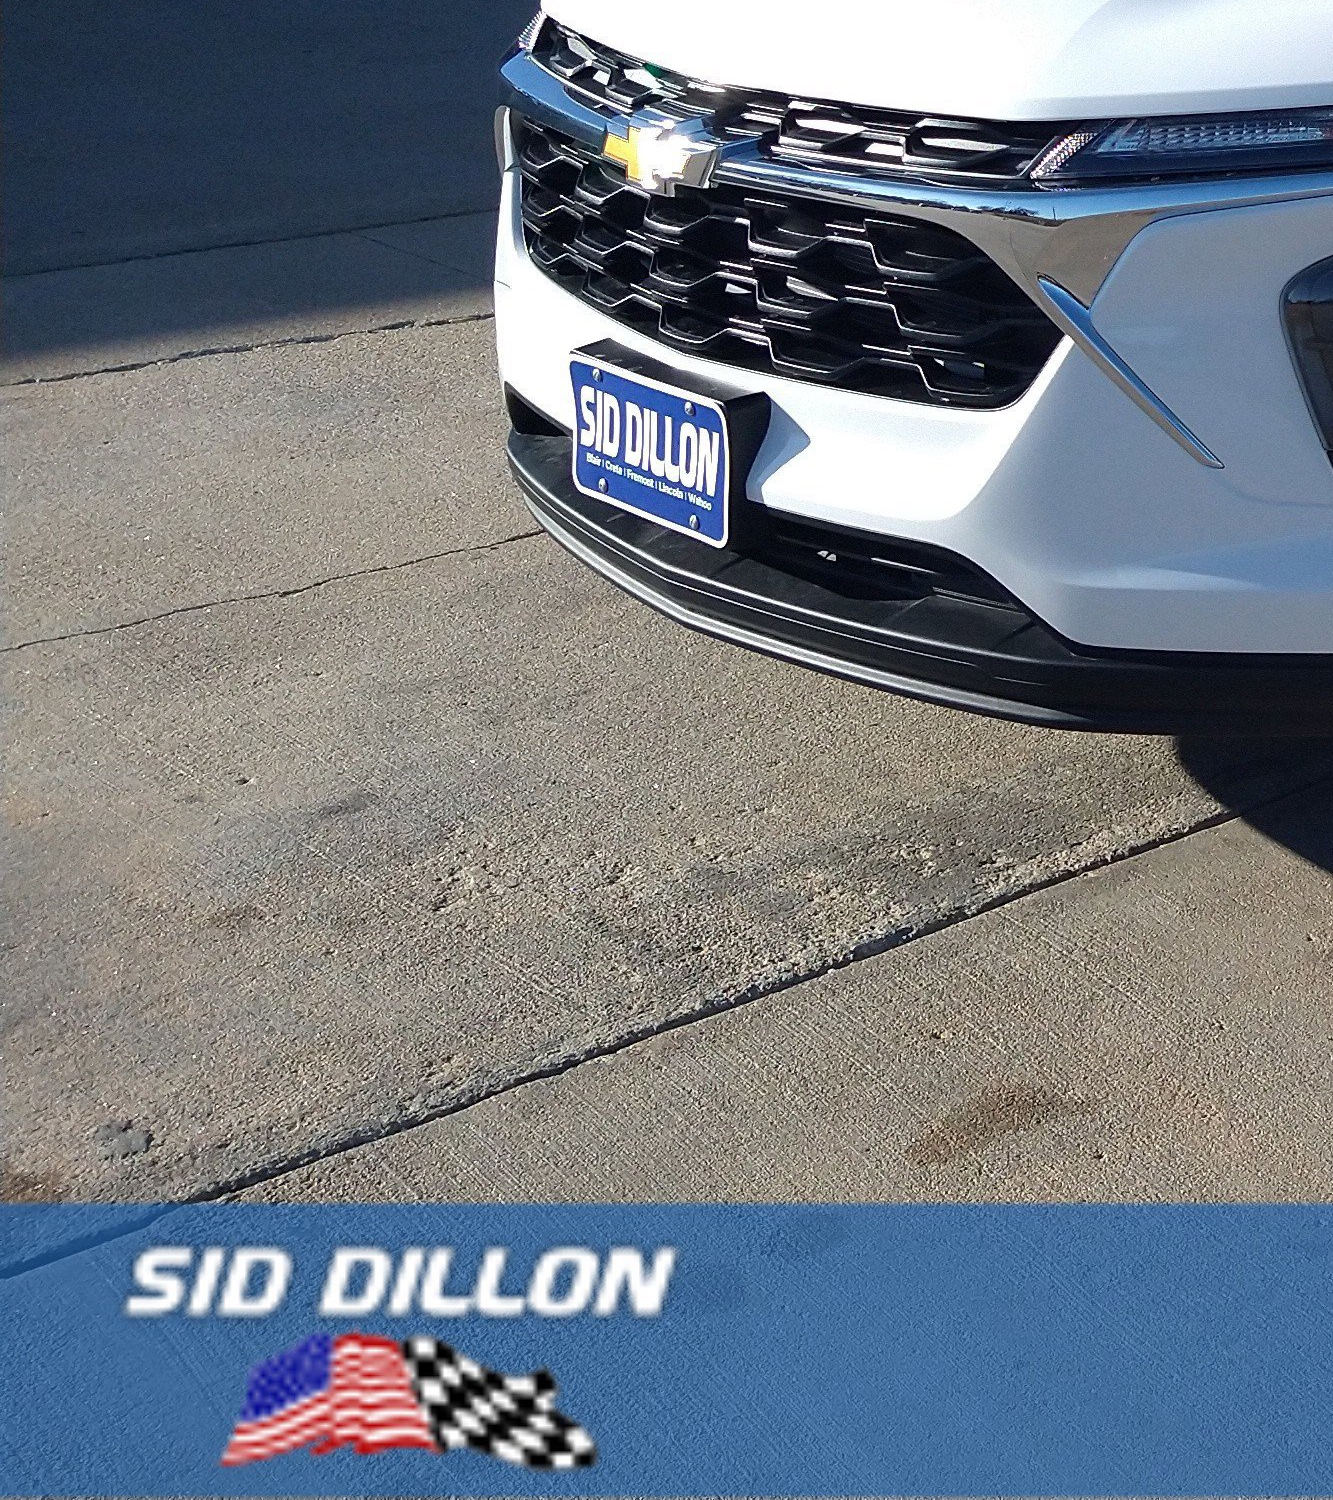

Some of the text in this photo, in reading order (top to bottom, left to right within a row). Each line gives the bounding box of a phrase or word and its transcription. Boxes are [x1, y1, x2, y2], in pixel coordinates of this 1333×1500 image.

[580, 384, 720, 497] SID DILLON
[586, 452, 602, 467] Blair
[626, 468, 655, 489] Fremont
[658, 481, 684, 500] Lincoln
[688, 492, 713, 511] Wahoo
